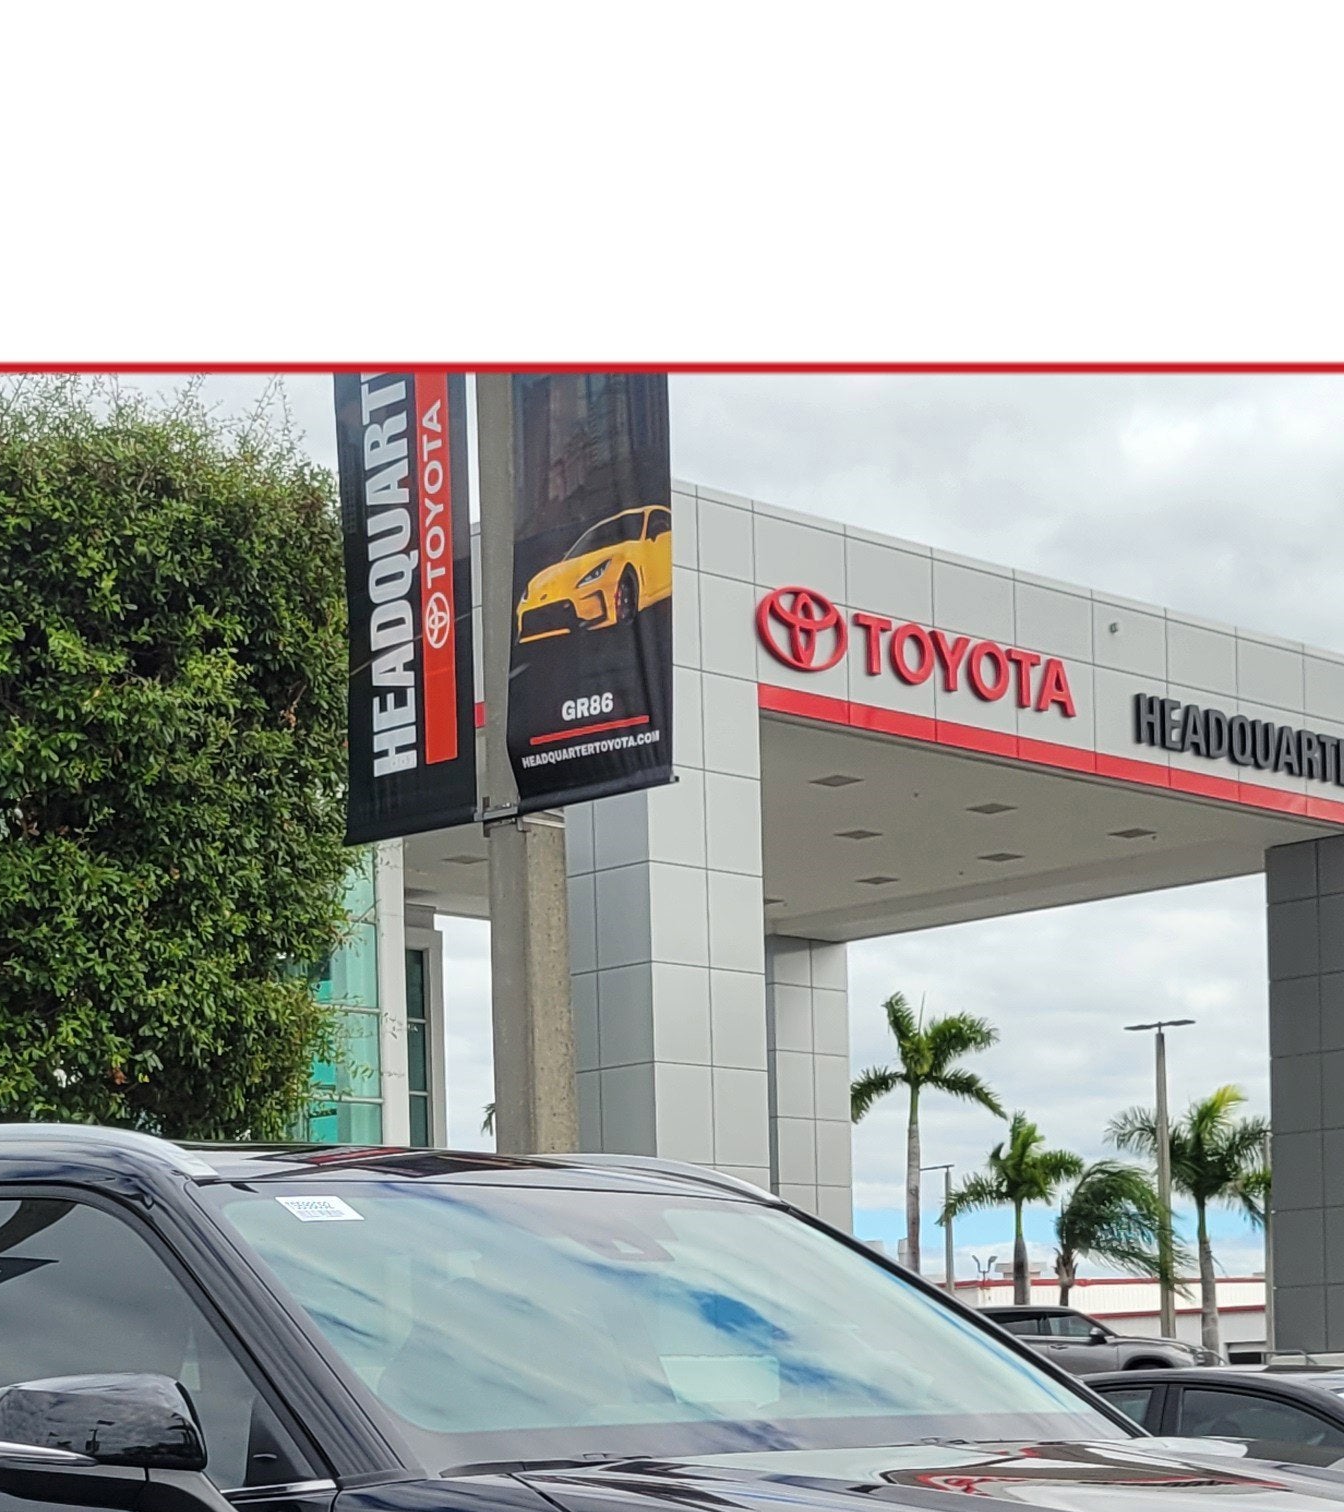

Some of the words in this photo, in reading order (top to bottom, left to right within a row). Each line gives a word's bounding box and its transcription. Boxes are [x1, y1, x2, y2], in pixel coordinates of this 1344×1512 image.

[422, 399, 446, 590] TOYOTA
[853, 612, 1076, 718] TOYOTA
[561, 692, 614, 721] GR86
[522, 730, 660, 769] HEADQUARTERTOYOTA.COM
